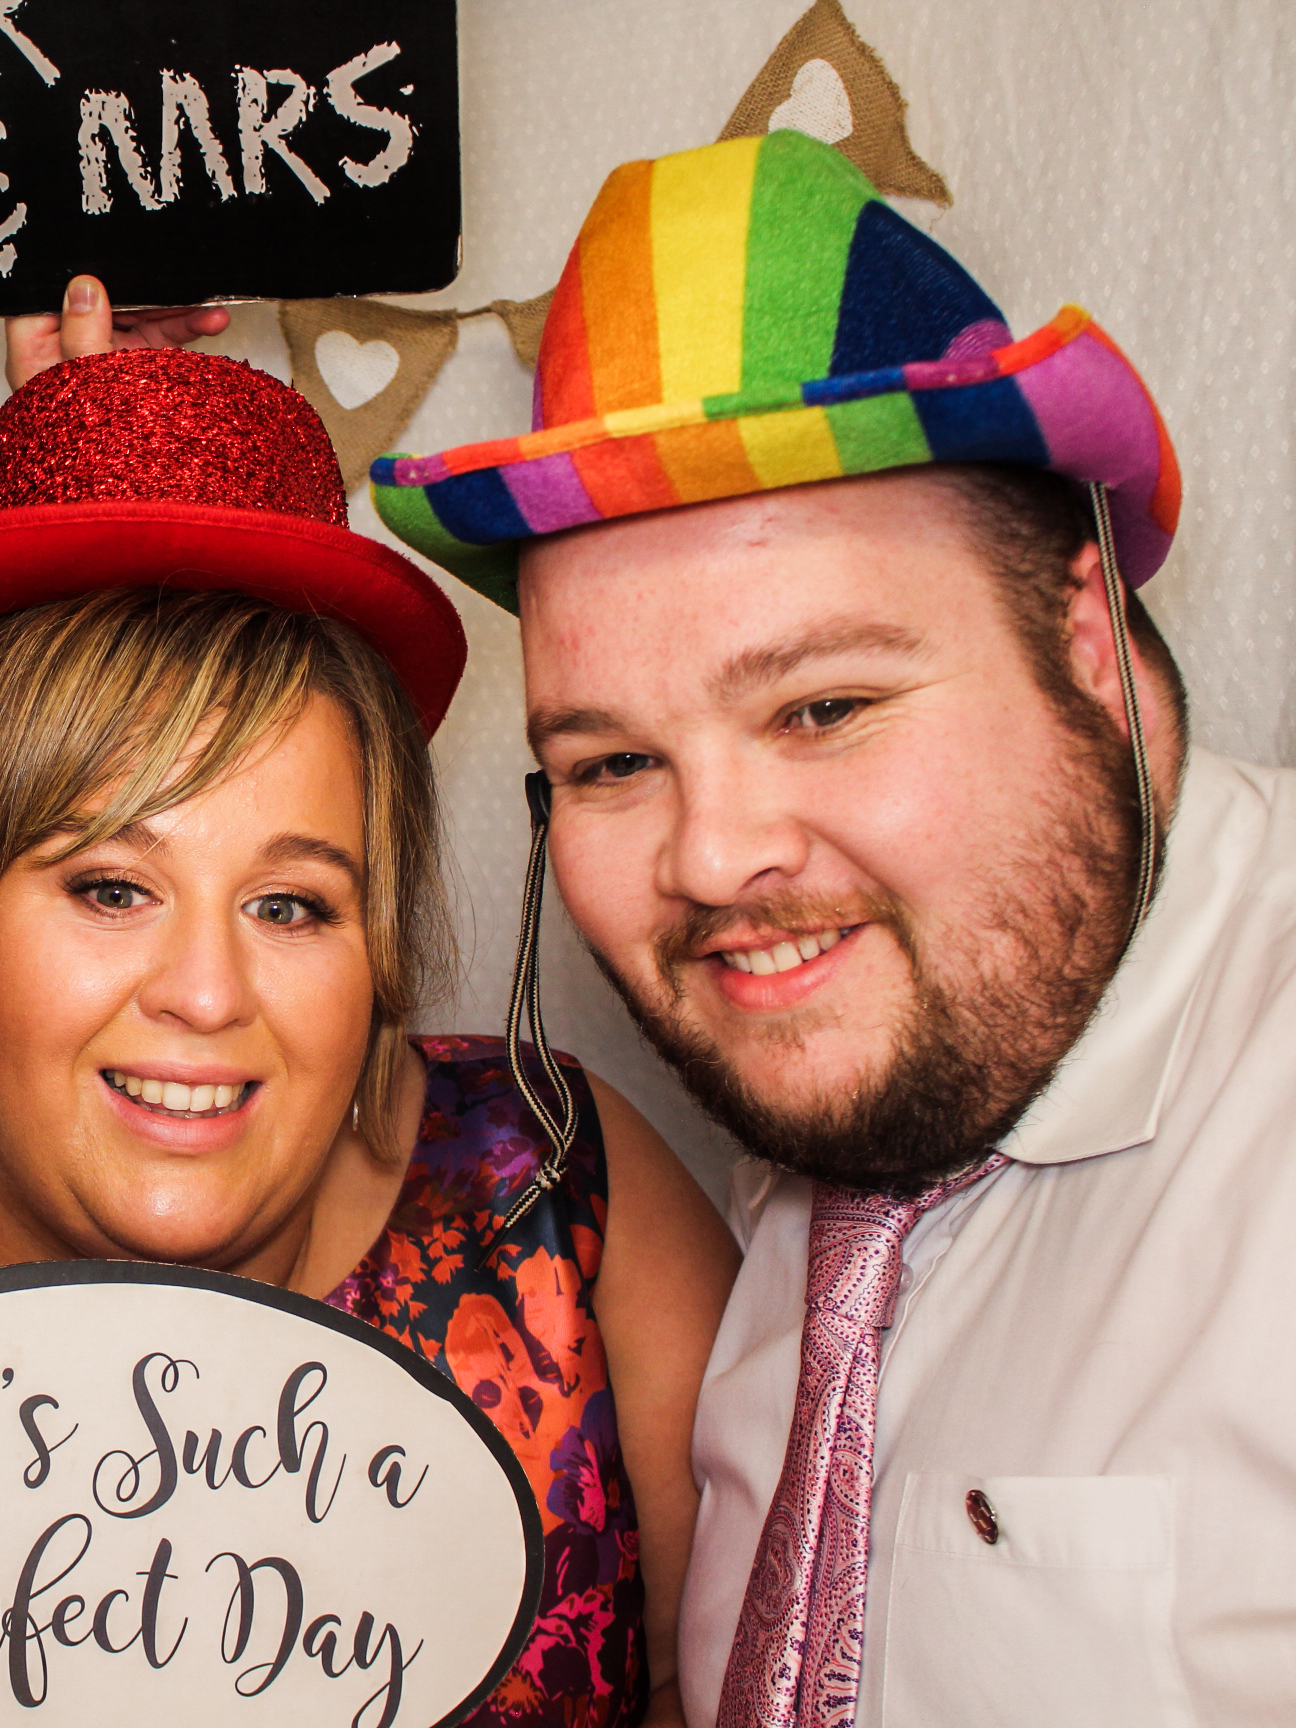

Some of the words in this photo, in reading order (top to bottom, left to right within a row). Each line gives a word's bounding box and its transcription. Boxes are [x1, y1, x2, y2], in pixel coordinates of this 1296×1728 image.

[92, 1352, 347, 1524] Such
[367, 1444, 430, 1509] a
[204, 1551, 426, 1728] Day
